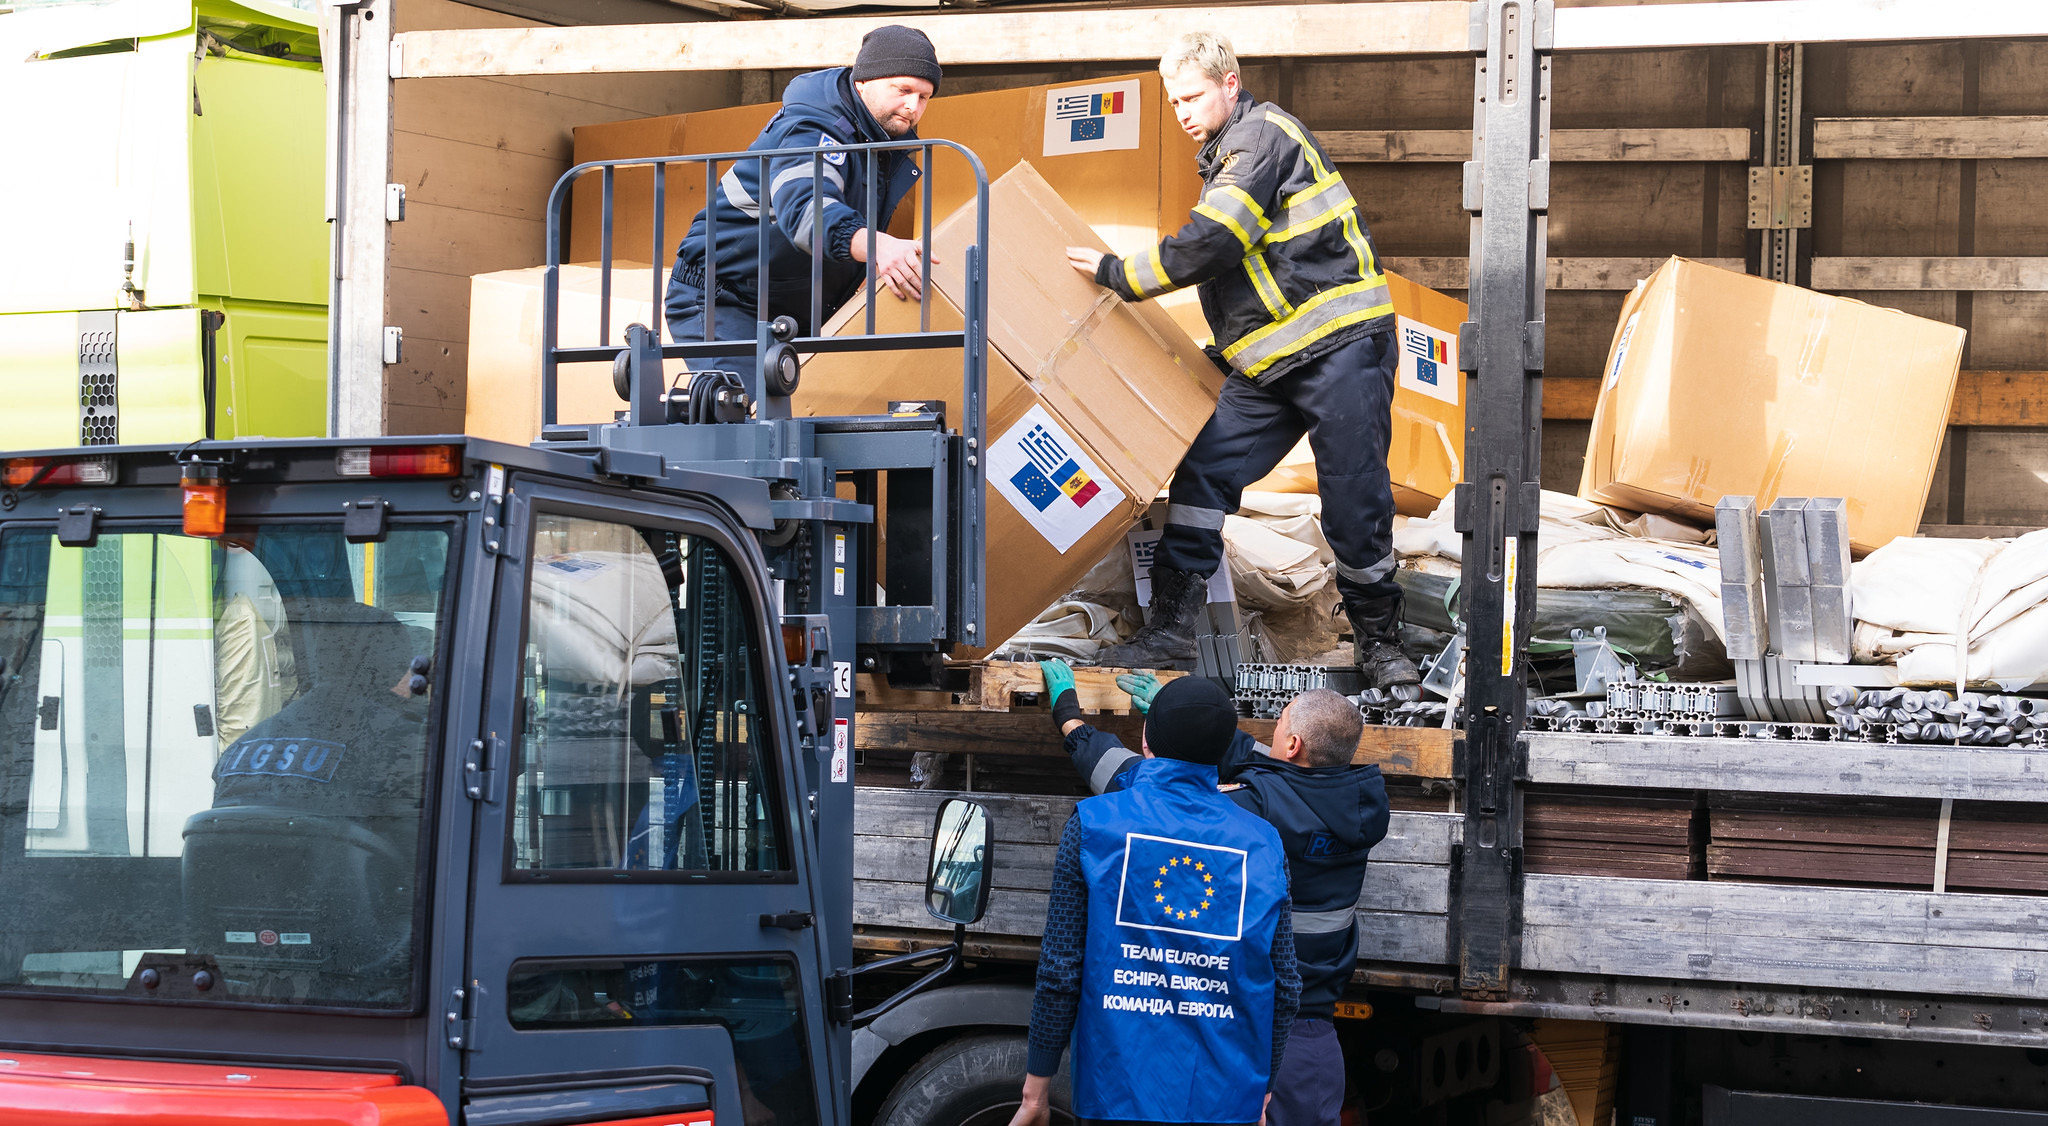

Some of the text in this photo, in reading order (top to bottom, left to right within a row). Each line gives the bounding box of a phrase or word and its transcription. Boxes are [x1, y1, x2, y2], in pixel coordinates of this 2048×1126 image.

[230, 743, 331, 773] IGSU
[1120, 943, 1230, 971] TEAM EUROPE
[1113, 968, 1229, 995] ECHIPA EUROPA
[1102, 994, 1235, 1019] КОМАНДА ЕВРОПА
